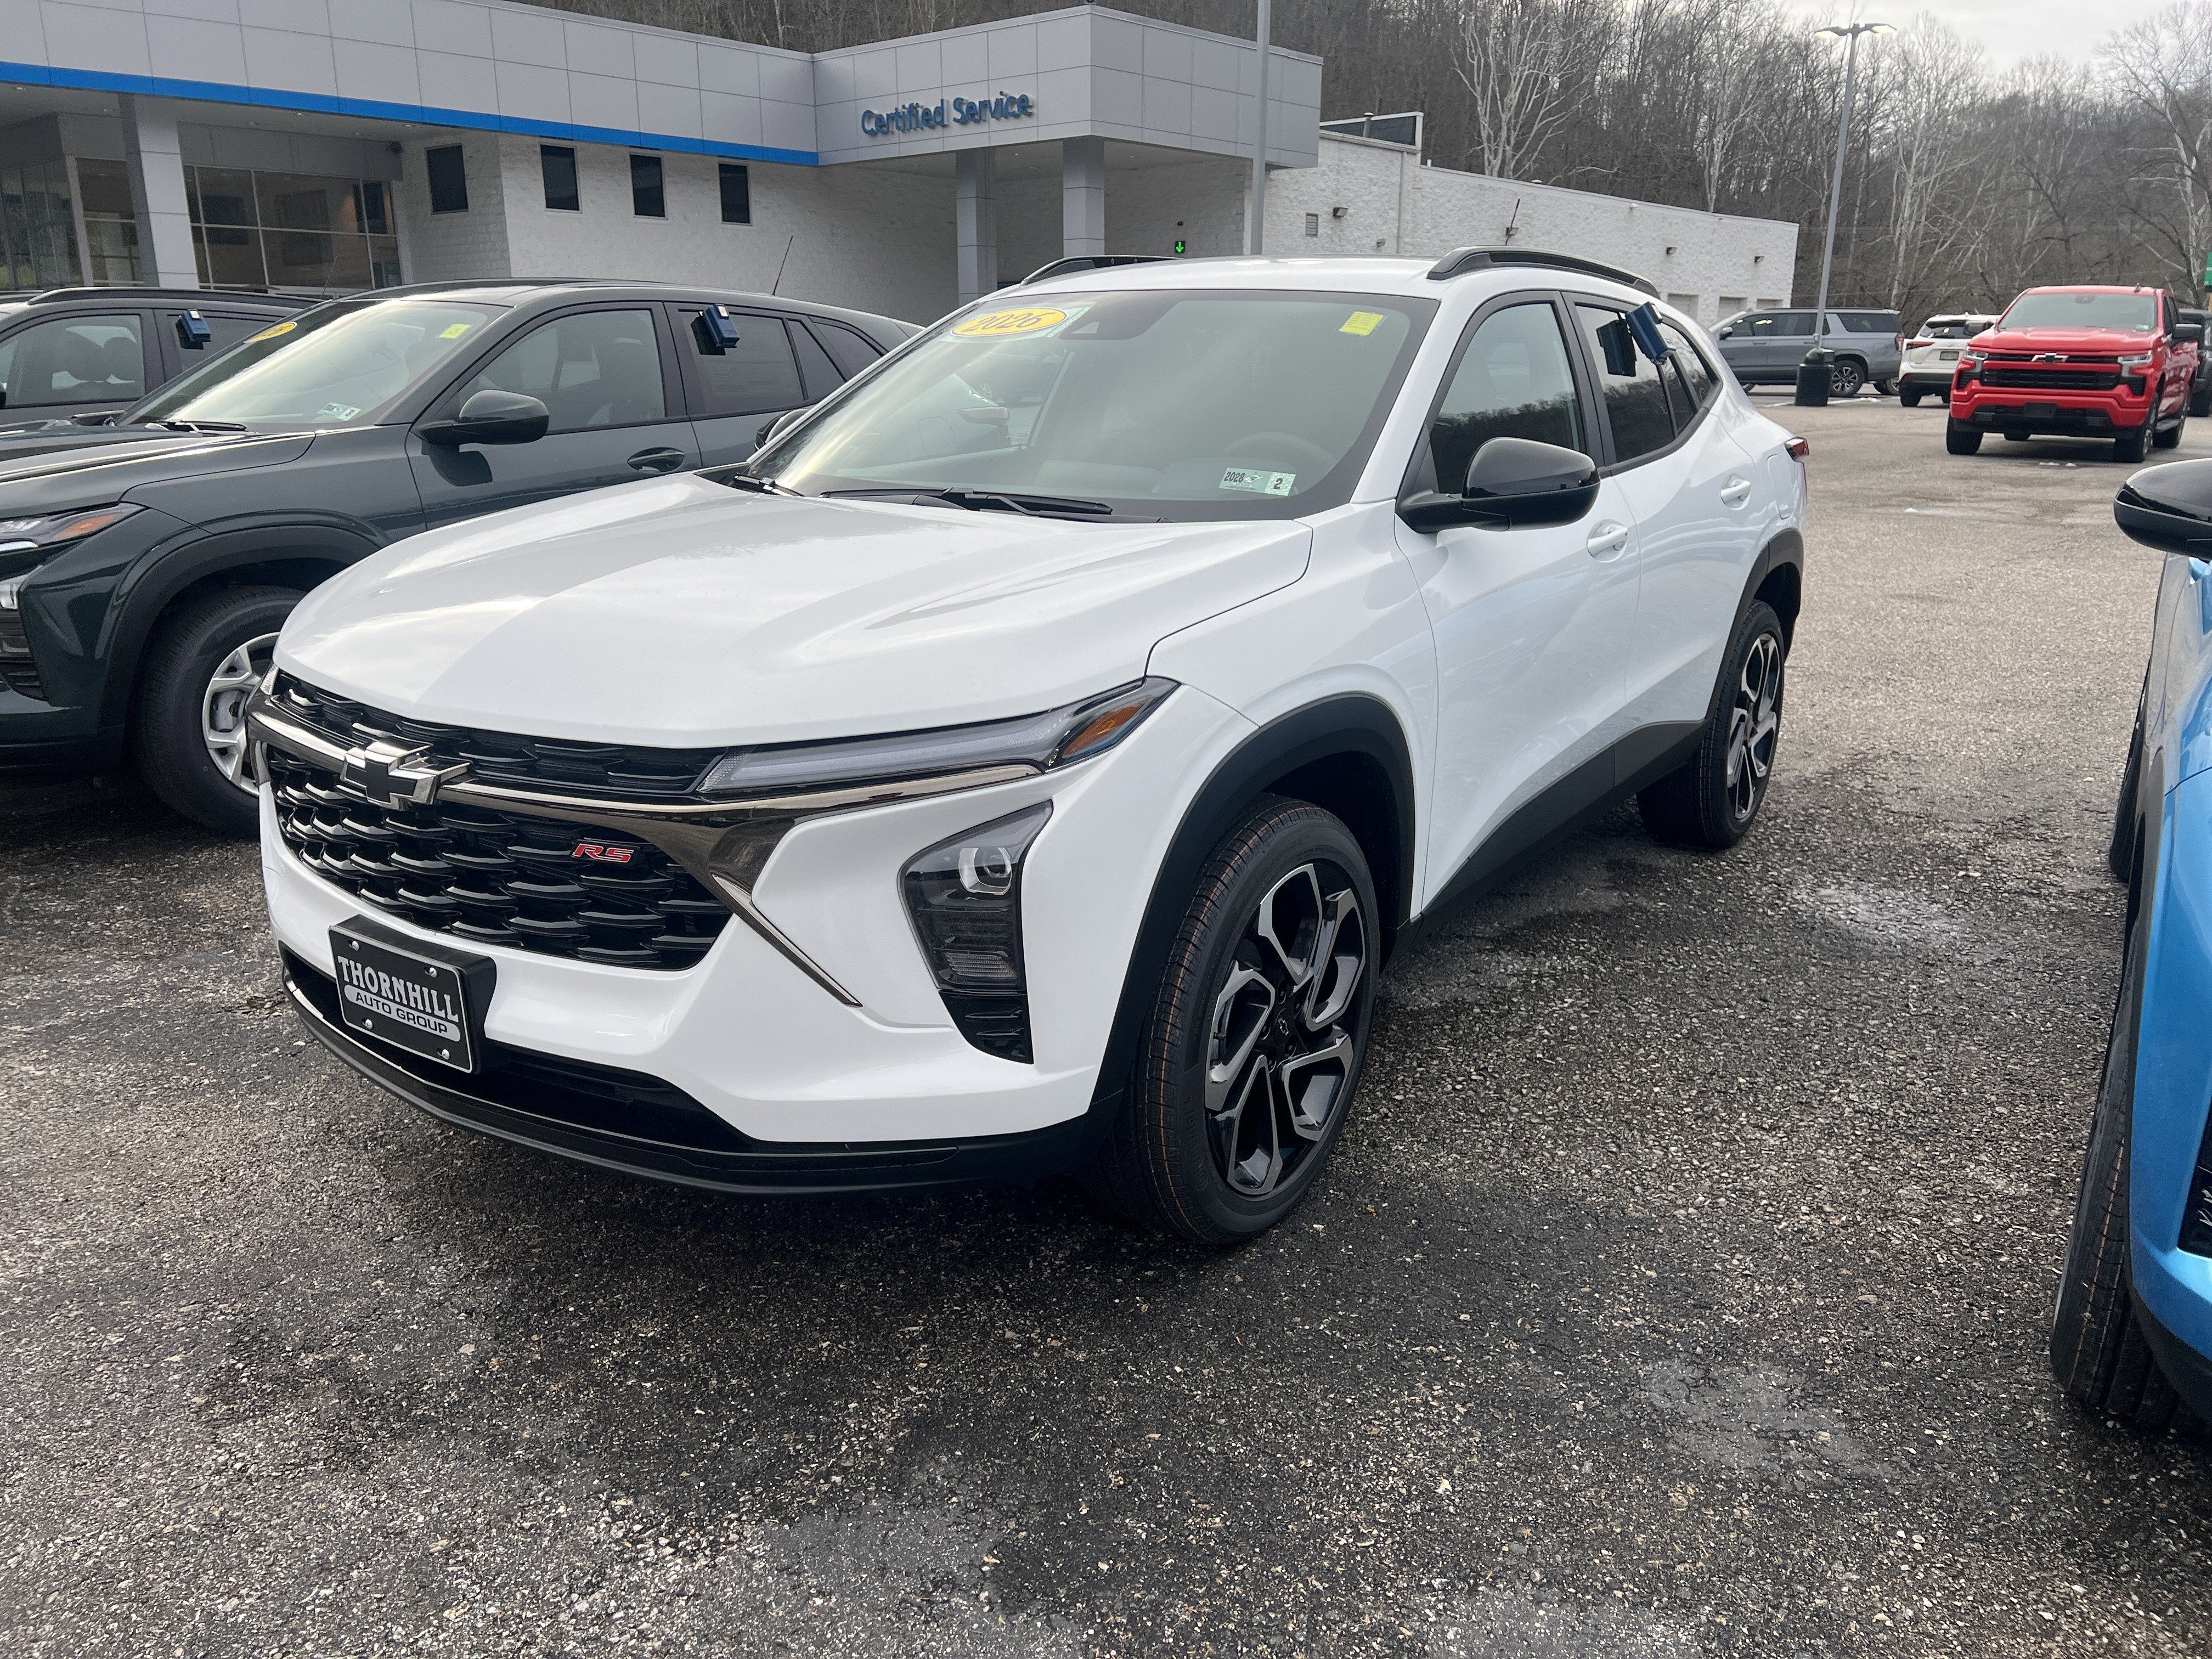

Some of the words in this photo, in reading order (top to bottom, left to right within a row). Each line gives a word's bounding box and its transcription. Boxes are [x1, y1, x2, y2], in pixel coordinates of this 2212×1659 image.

[861, 98, 946, 136] Certified
[953, 91, 1033, 125] Service
[961, 312, 1056, 332] 2026
[1223, 471, 1245, 483] 2028
[1273, 477, 1283, 489] 2
[572, 843, 634, 863] RS
[337, 956, 459, 1023] THORNHILL
[356, 992, 391, 1015] AUTO
[396, 1008, 448, 1034] GROUP
